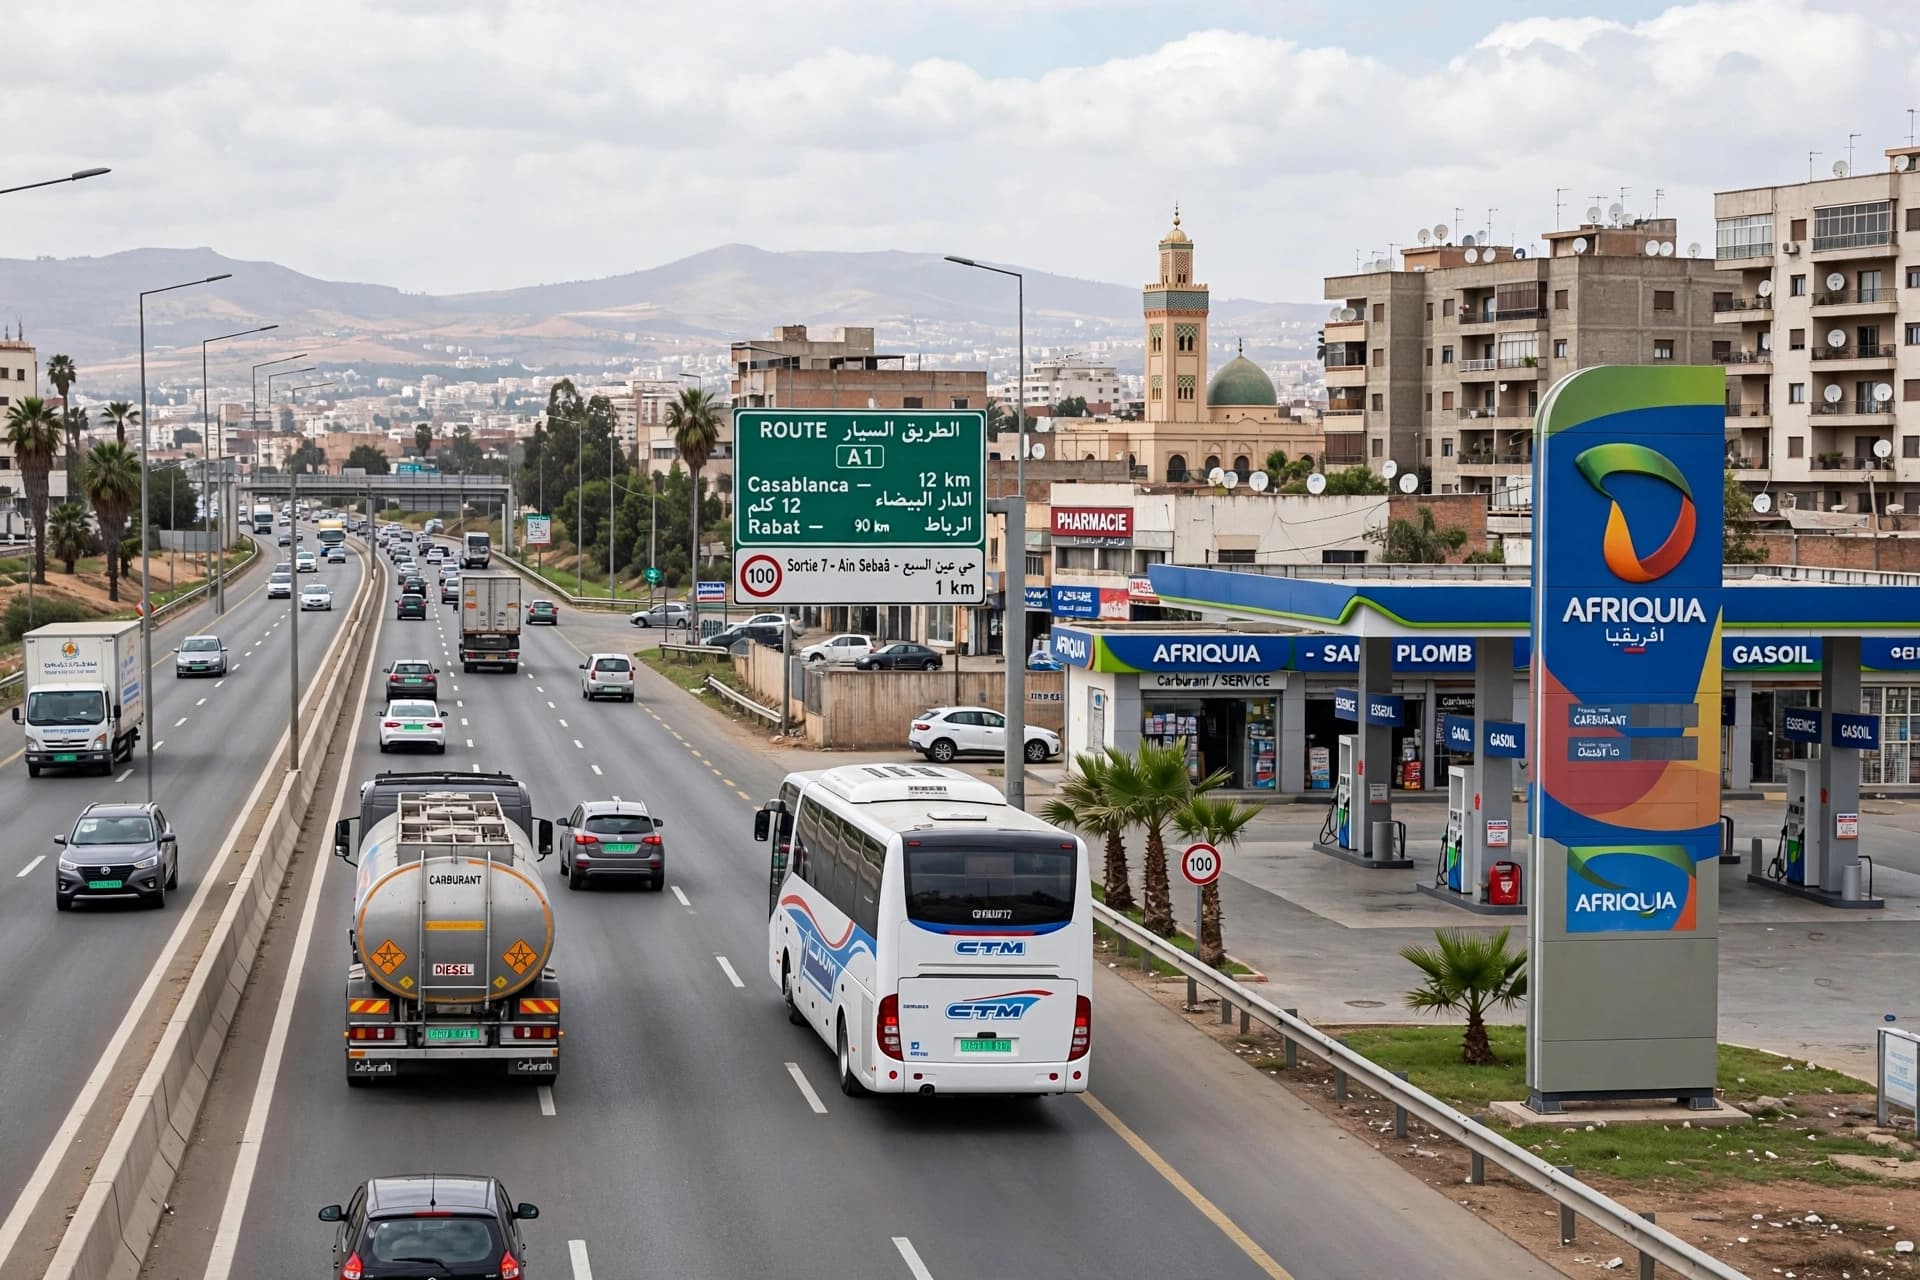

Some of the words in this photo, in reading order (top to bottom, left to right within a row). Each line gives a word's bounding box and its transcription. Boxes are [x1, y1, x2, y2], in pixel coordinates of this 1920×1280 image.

[760, 421, 828, 439] ROUTE
[843, 420, 895, 442] السيار
[902, 420, 960, 443] الطريق
[846, 448, 873, 466] A1
[747, 476, 849, 493] Casablanca
[918, 472, 937, 488] 12
[944, 472, 971, 488] km
[748, 496, 776, 518] كلم
[782, 498, 801, 513] 12
[875, 490, 932, 511] البيضاء
[937, 491, 972, 511] الدار
[748, 518, 801, 535] Rabat
[854, 519, 871, 533] 90
[874, 522, 890, 533] km
[923, 516, 972, 536] الرباط
[1057, 512, 1127, 531] PHARMACIE
[787, 558, 818, 573] Sortie
[820, 559, 828, 572] 7
[838, 558, 856, 572] Ain
[859, 557, 891, 573] Sebaâ
[902, 558, 932, 577] السبع
[958, 562, 976, 577] حي
[749, 568, 775, 584] 100
[935, 580, 942, 595] 1
[950, 580, 975, 596] km
[1562, 596, 1707, 624] AFRIQUIA
[1605, 627, 1665, 648] افريقيا
[1153, 643, 1261, 663] AFRIQUIA
[1396, 645, 1473, 662] PLOMB
[1732, 645, 1814, 664] GASOIL
[1221, 674, 1271, 687] SERVICE
[1490, 732, 1518, 750] GASOIL
[1841, 723, 1873, 741] GASOIL
[1189, 857, 1213, 872] 100
[429, 875, 482, 886] CARBURANT
[1575, 891, 1677, 915] AFRIQUIA
[956, 940, 1025, 955] CTM
[435, 963, 472, 976] DIESEL
[946, 1003, 1024, 1019] CTM
